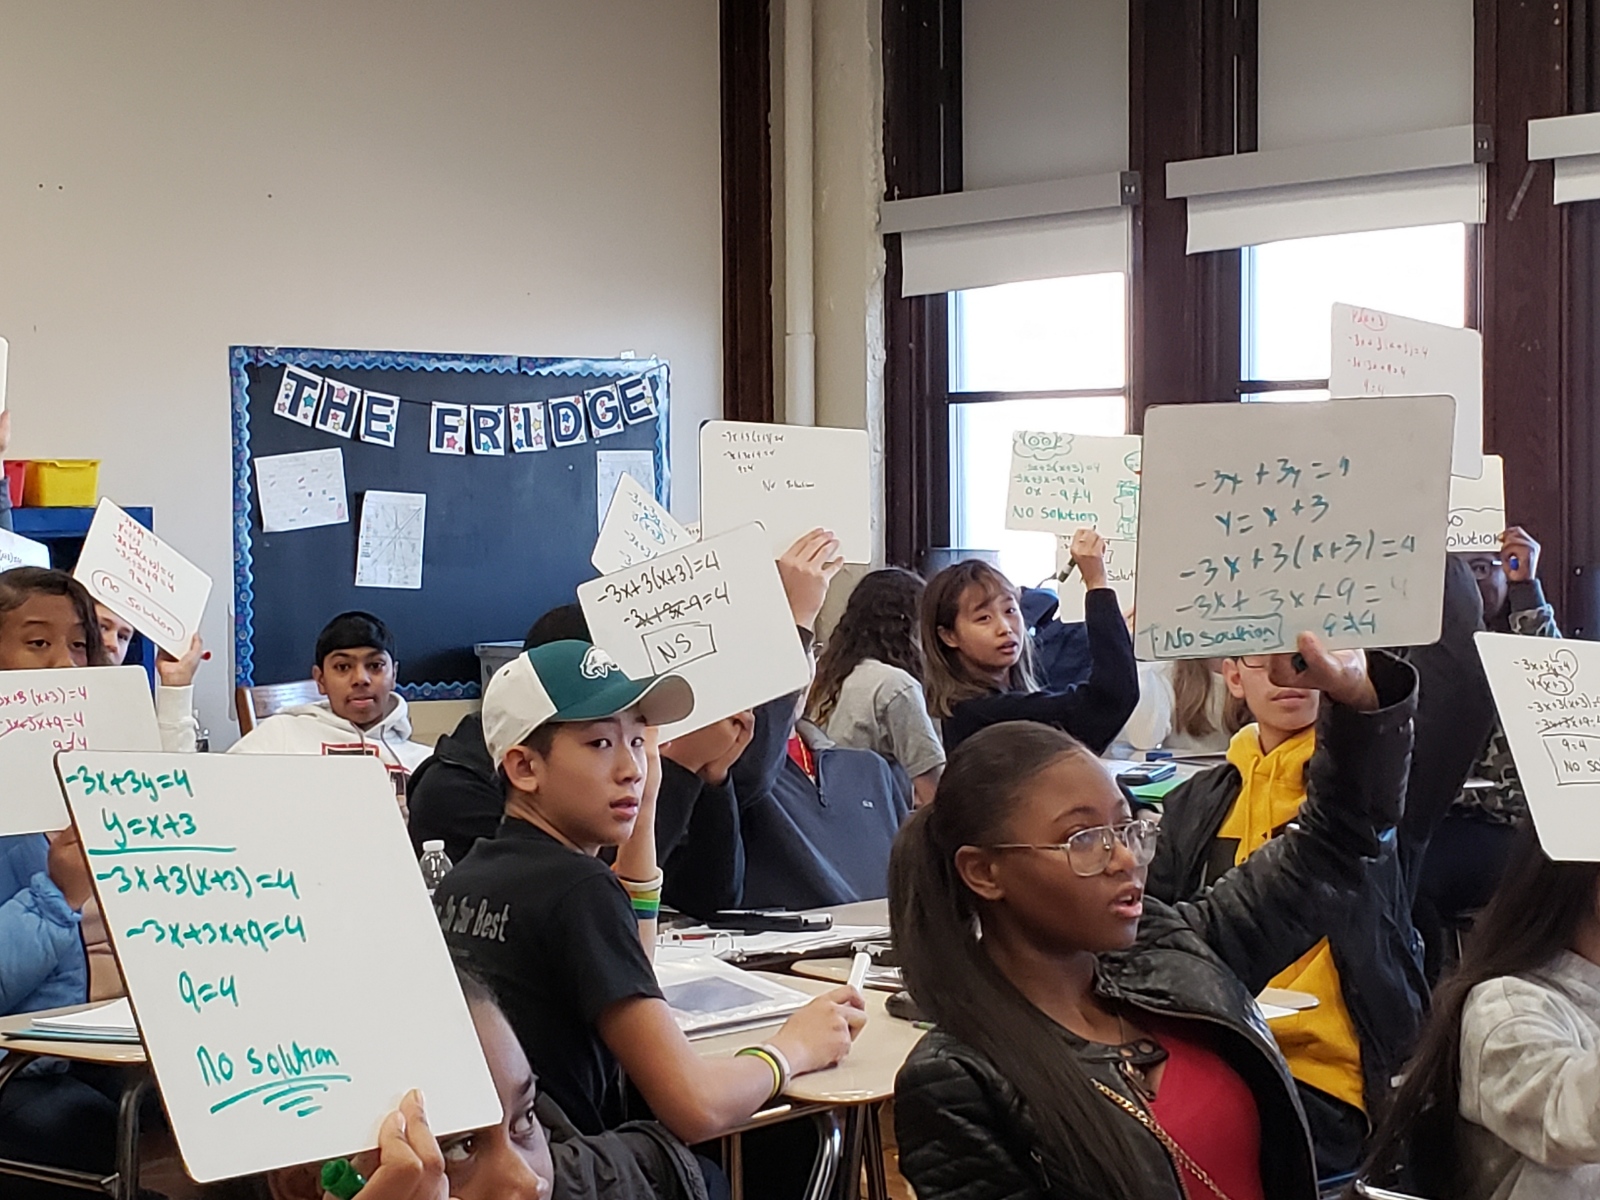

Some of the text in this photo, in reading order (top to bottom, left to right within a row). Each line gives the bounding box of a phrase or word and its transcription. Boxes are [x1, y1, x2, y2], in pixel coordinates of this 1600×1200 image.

[285, 370, 654, 449] THE FRIDGE
[1041, 506, 1099, 523] Solution
[657, 633, 692, 663] NS
[1164, 626, 1194, 650] No
[472, 898, 510, 942] Best
